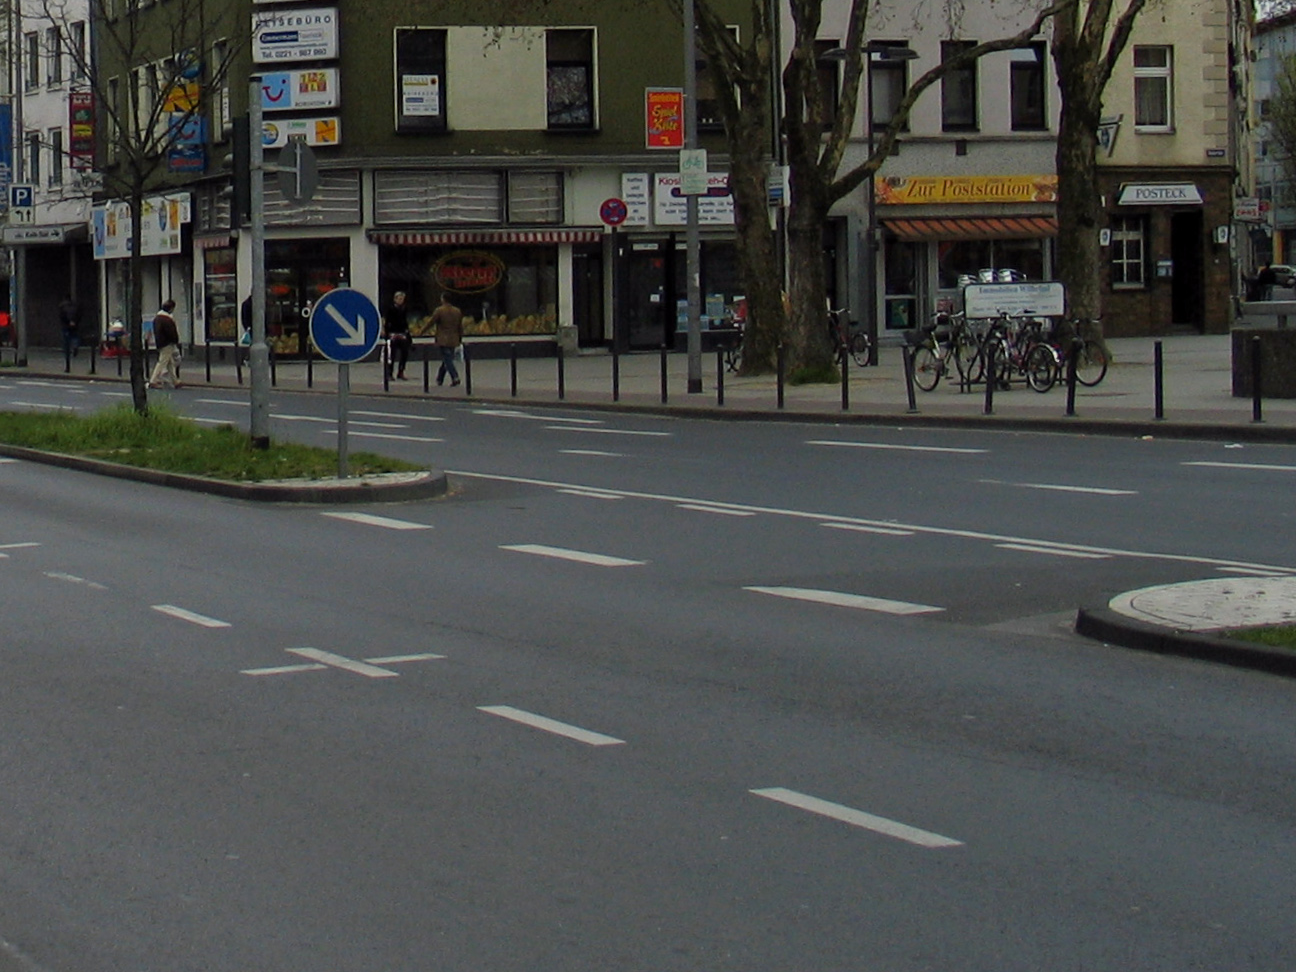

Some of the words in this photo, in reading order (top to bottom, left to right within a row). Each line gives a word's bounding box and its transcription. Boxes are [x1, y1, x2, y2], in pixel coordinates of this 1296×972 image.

[659, 177, 681, 185] Kios
[907, 180, 935, 197] Zur
[942, 179, 1031, 196] Poststation
[1136, 188, 1187, 199] POSTECK
[16, 189, 27, 205] P
